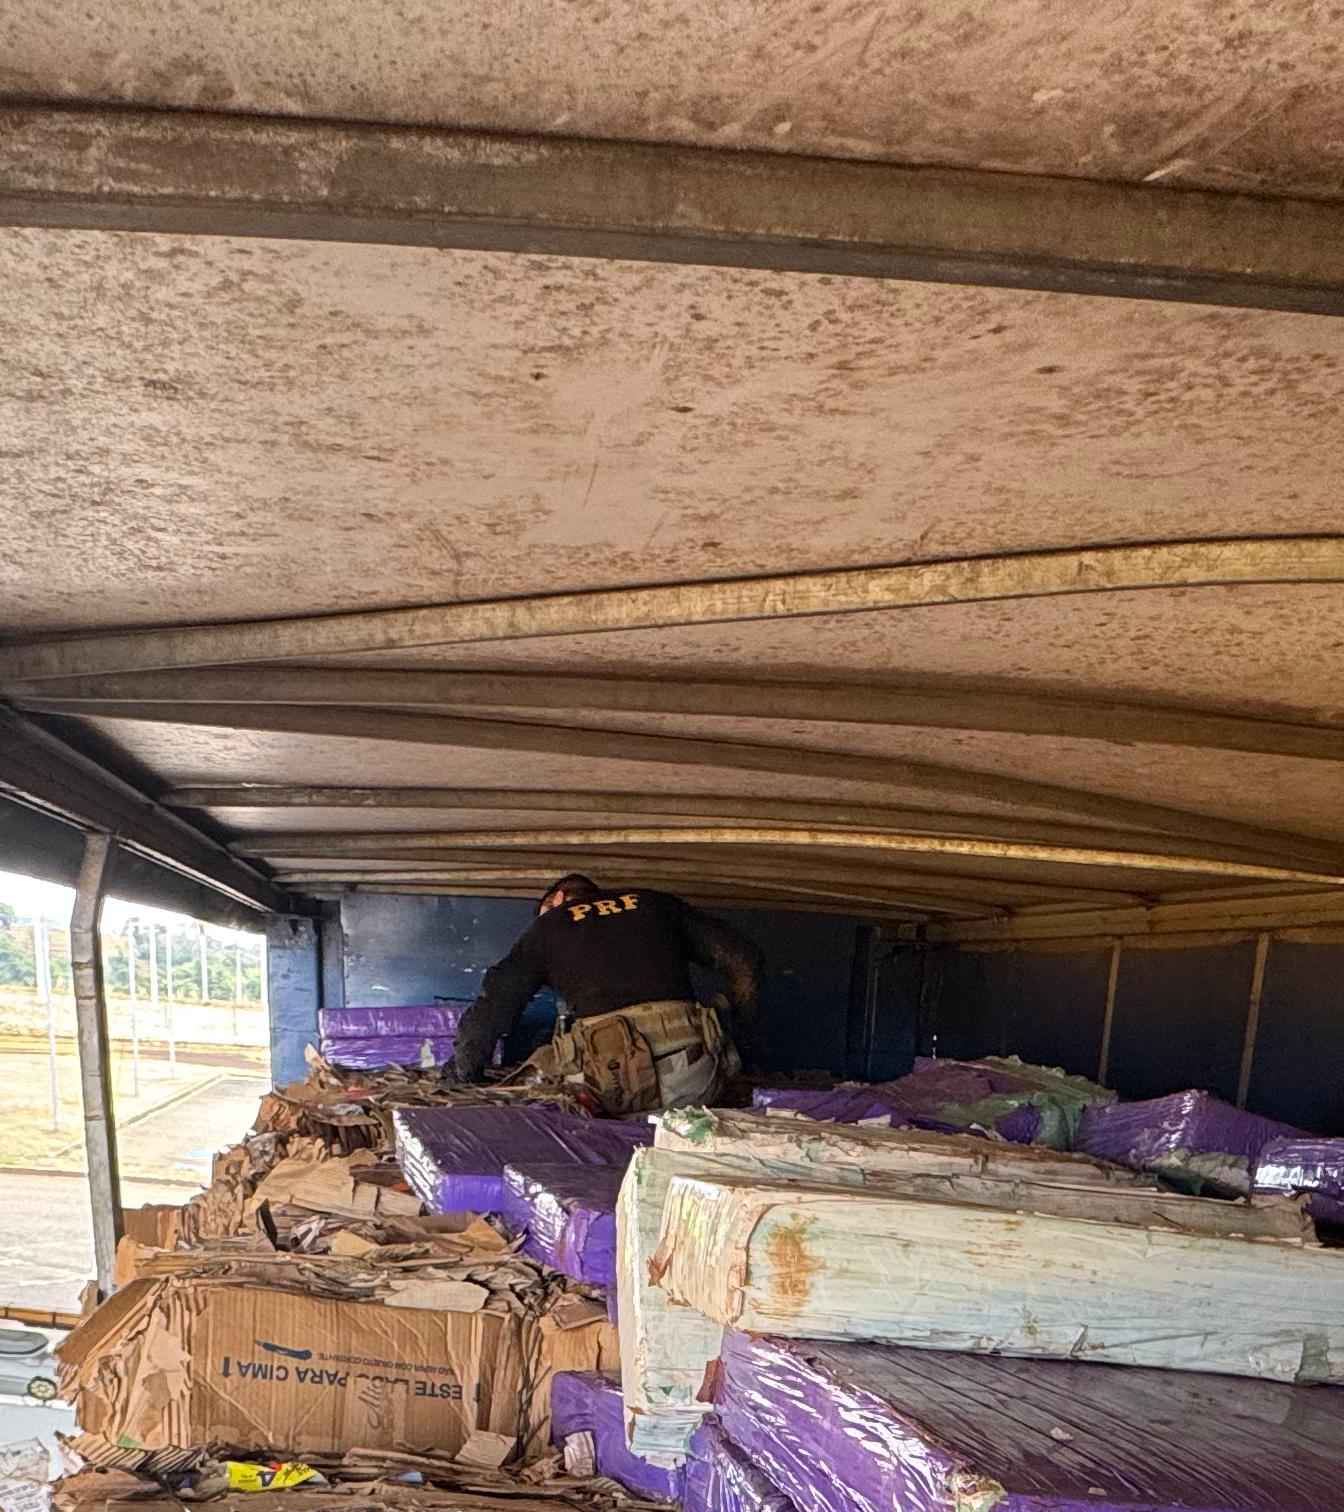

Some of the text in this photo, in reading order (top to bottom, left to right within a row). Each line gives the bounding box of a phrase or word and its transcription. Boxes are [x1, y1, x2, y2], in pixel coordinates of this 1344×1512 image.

[567, 893, 640, 921] PRF
[236, 1360, 289, 1382] CIMA
[295, 1366, 349, 1388] PARA
[414, 1380, 463, 1400] ESTE
